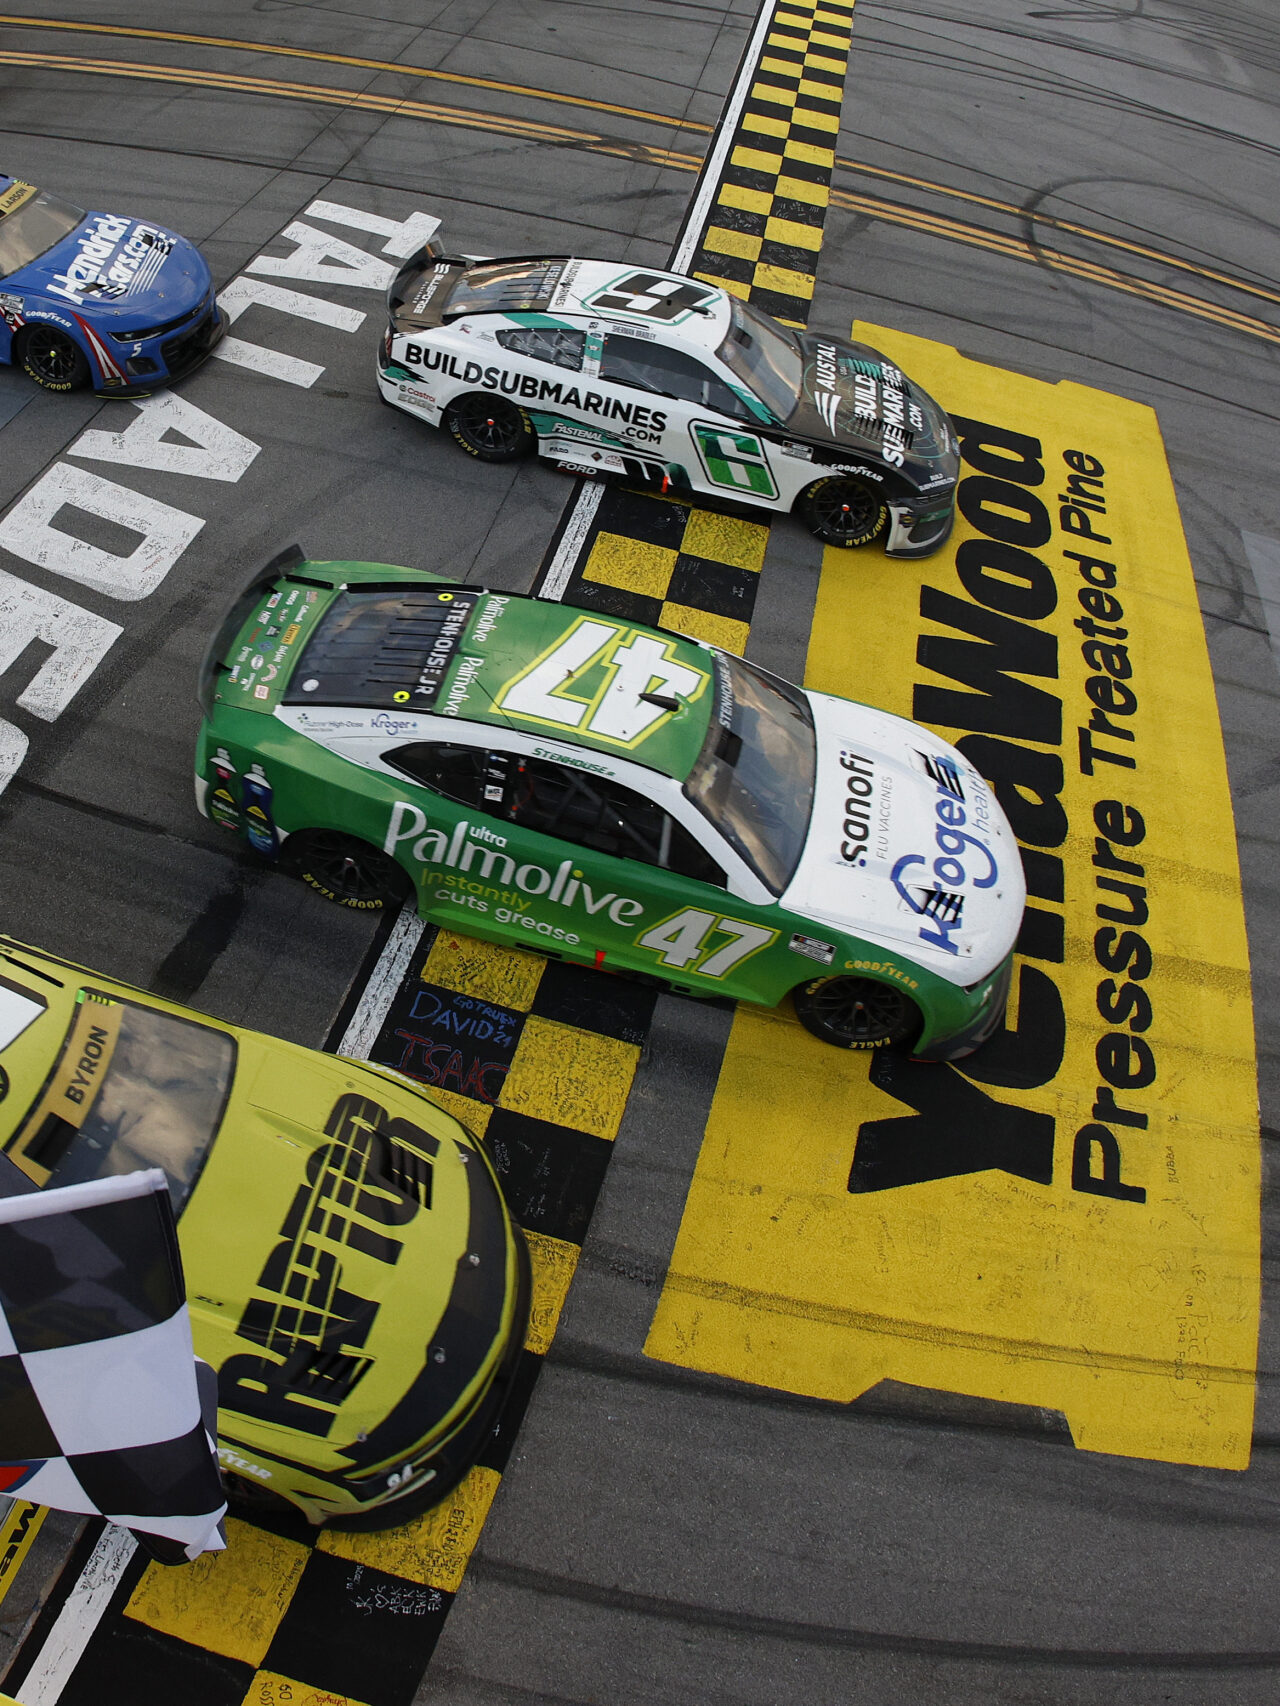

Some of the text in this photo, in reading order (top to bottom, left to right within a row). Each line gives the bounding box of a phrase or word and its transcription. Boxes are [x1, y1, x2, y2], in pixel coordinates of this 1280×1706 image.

[0, 187, 28, 210] LARSON
[46, 213, 131, 306] Hendrick
[24, 310, 73, 329] GOODYEAR
[131, 343, 143, 358] 5
[816, 344, 837, 392] AUSTAL
[404, 342, 669, 434] BUILDSUBMARINES
[407, 387, 437, 403] Castrol
[854, 373, 878, 422] BUILD
[551, 422, 604, 443] FASTENAL
[620, 426, 662, 446] .COM
[908, 403, 924, 432] .COM
[556, 459, 599, 477] FORD
[690, 420, 778, 500] 6
[830, 463, 884, 483] GOODYEAR
[1058, 448, 1112, 546] Pine
[845, 505, 887, 547] GOODYEAR
[471, 595, 510, 643] Palmolive
[442, 656, 485, 716] Palmolive
[494, 617, 708, 747] 47
[1062, 550, 1139, 777] Treated
[718, 666, 733, 729] STENHOUSE
[370, 713, 412, 736] Kroger
[531, 747, 607, 777] STENHOUSE
[839, 750, 876, 869] sanofi
[876, 775, 894, 861] FLU VACCINES
[969, 767, 992, 835] health
[469, 825, 508, 849] ultra
[383, 800, 645, 928] Palmolive
[302, 873, 384, 910] GOODYEAR
[421, 867, 533, 912] Instantly
[434, 888, 582, 946] cuts grease
[635, 906, 781, 979] 47
[844, 960, 920, 991] GOODYEAR
[408, 990, 495, 1041] DAVID
[1070, 799, 1157, 1205] Pressure
[63, 1024, 110, 1107] BYRON
[384, 1027, 511, 1107] ISAAC
[848, 1036, 893, 1051] EAGLE
[217, 1092, 442, 1438] RAPTOR
[217, 1448, 273, 1481] YEAR
